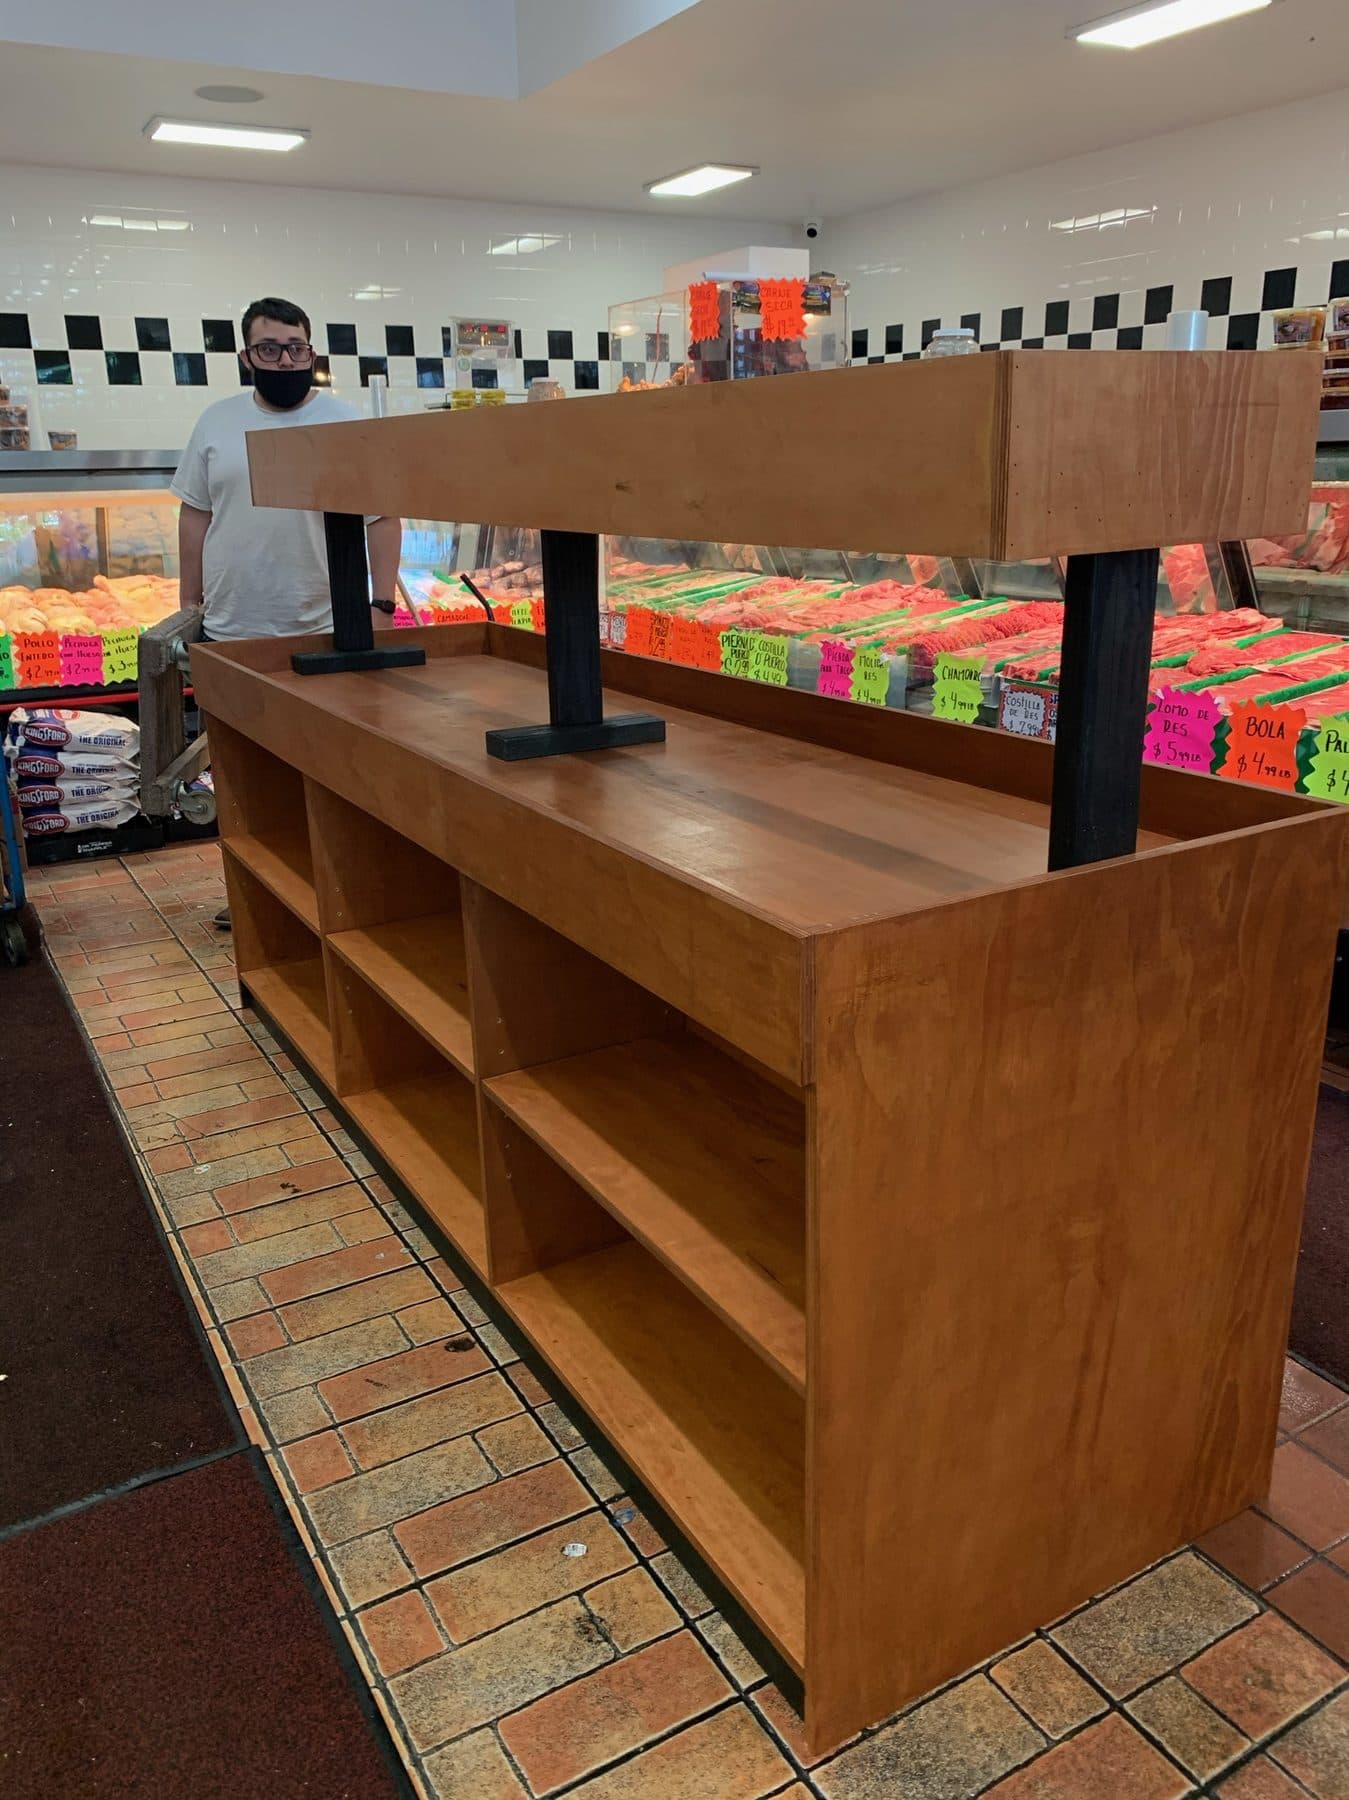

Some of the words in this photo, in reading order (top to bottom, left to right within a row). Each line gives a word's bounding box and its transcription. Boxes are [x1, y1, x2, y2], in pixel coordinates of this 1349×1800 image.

[766, 300, 793, 313] SECA
[24, 638, 54, 649] POLLO
[863, 671, 878, 682] RES
[1006, 695, 1041, 710] COSTILLA
[1009, 708, 1019, 717] DE
[1024, 710, 1039, 721] RES
[1157, 699, 1189, 717] LOMO
[1198, 709, 1209, 720] DE
[25, 727, 67, 742] KINGSFORD
[1163, 719, 1188, 737] RES
[1245, 716, 1286, 740] BOLA
[79, 735, 91, 744] THE
[17, 760, 60, 775] KINGSFORD
[72, 766, 84, 774] THE
[19, 789, 60, 804] KINGSFORD
[71, 789, 84, 798] THE
[76, 816, 89, 825] THE
